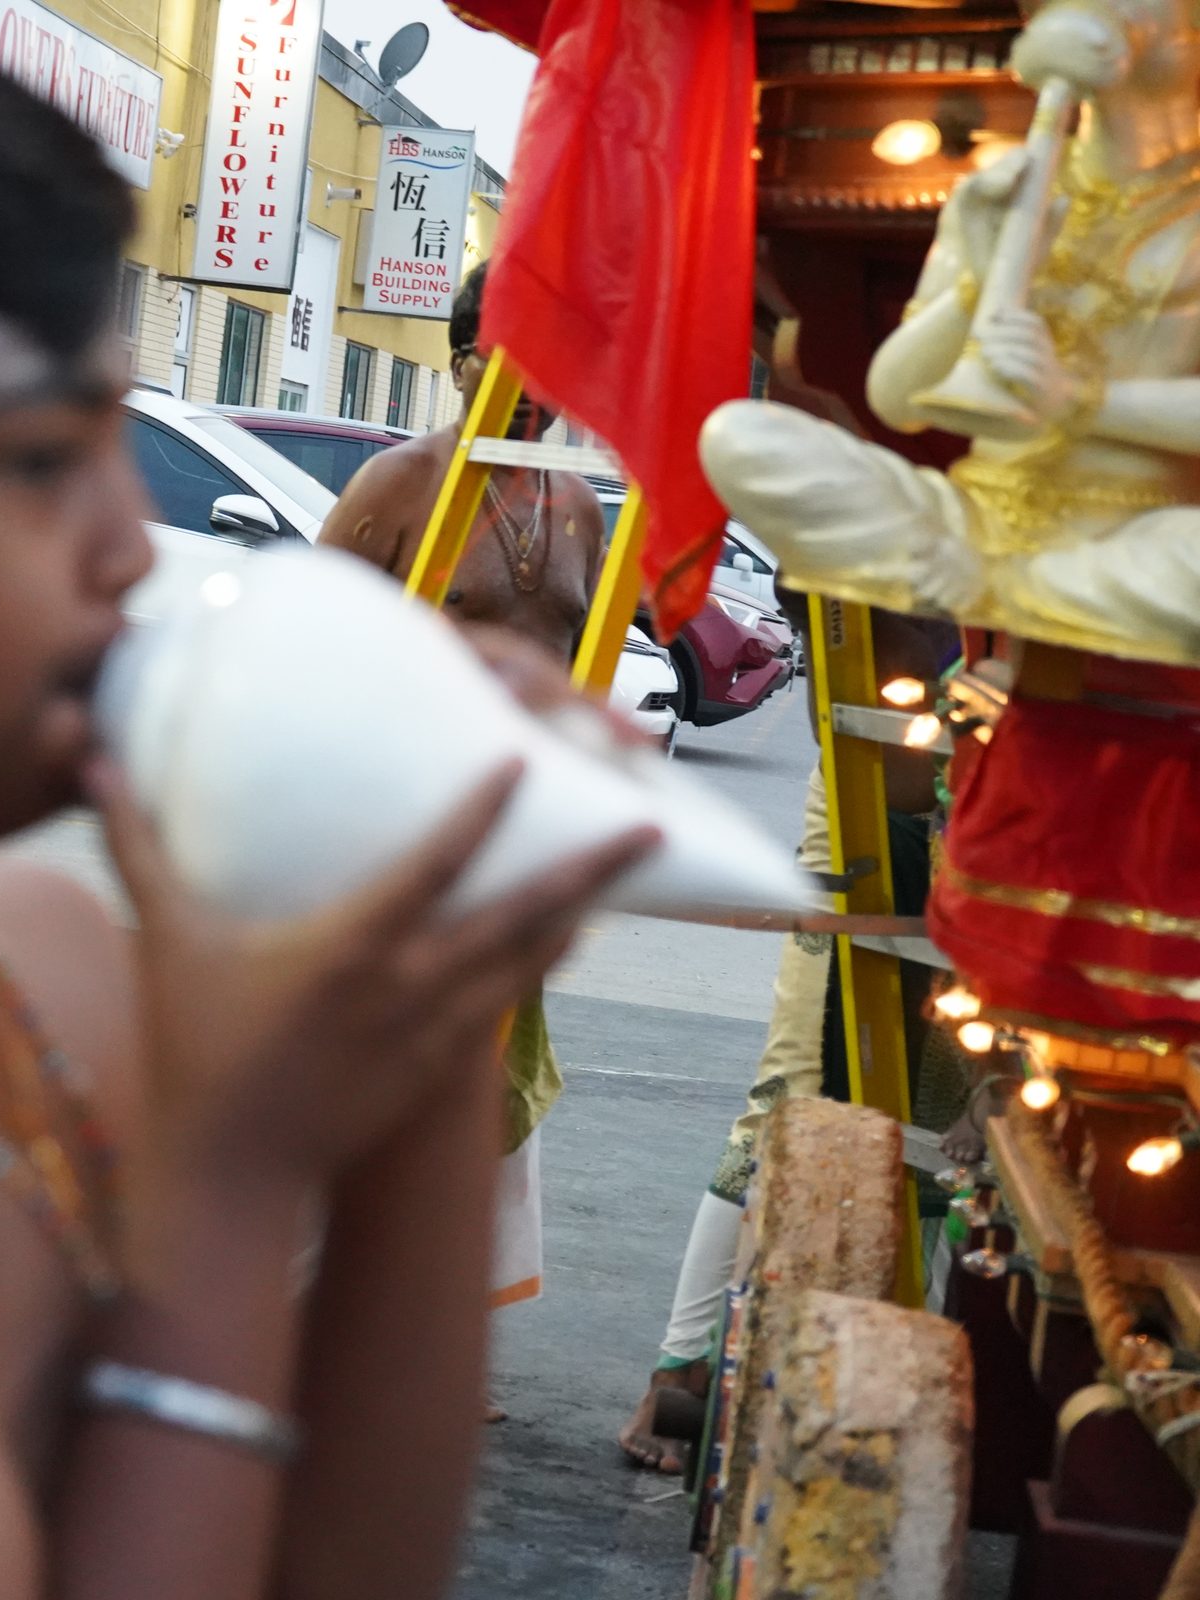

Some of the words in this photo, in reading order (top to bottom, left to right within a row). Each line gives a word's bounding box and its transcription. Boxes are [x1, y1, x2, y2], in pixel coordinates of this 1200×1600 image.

[214, 33, 257, 268] SUNFLOWERS
[254, 37, 297, 271] Furniture
[388, 137, 420, 157] HBS
[423, 148, 466, 160] HANSON
[380, 257, 447, 277] HANSON
[372, 273, 451, 293] BUILDING
[378, 290, 441, 308] SUPPLY
